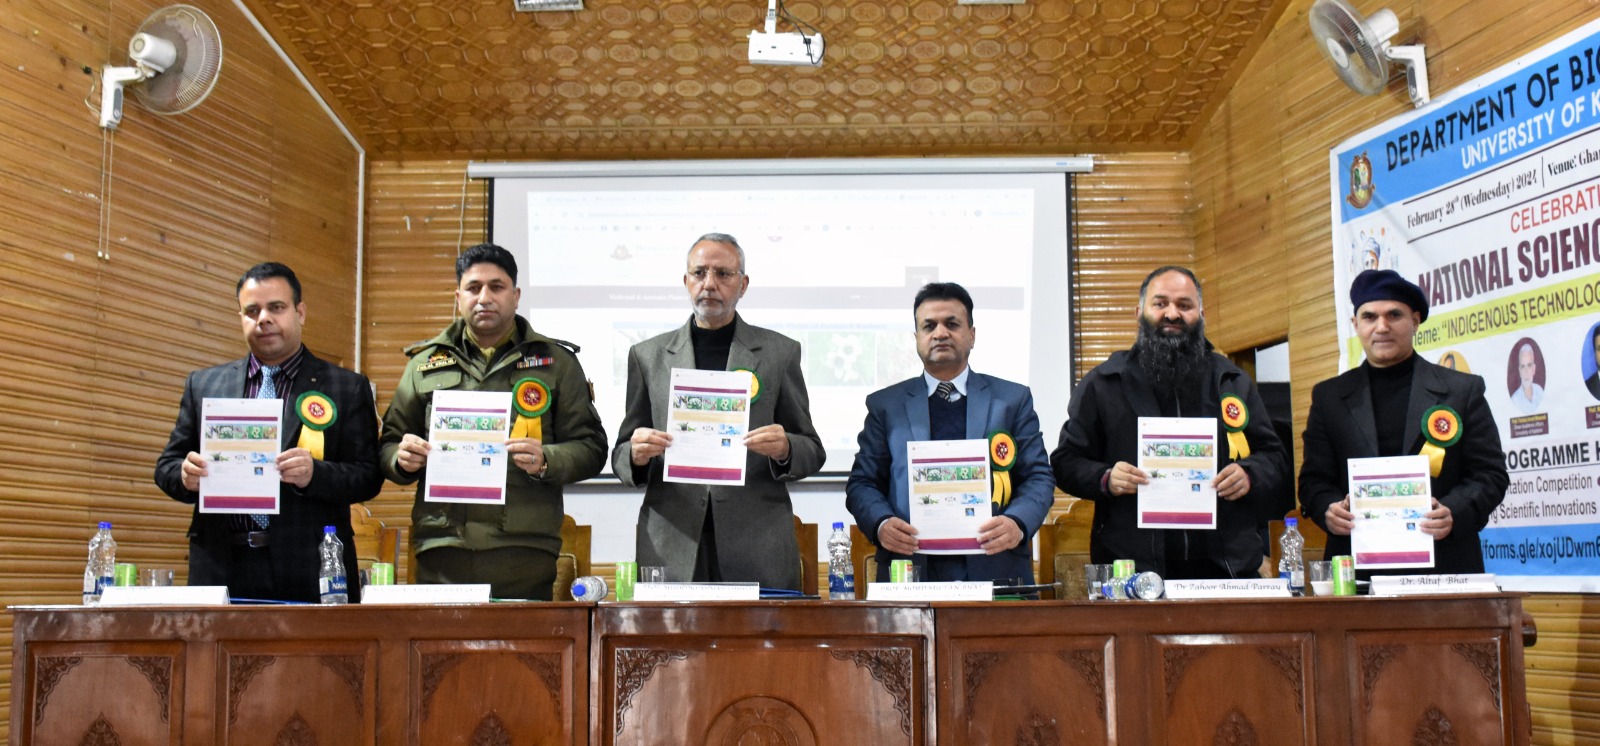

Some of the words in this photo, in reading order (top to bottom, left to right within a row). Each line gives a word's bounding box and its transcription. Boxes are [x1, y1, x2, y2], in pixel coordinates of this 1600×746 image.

[1386, 83, 1517, 172] DEPARTMENT
[1527, 63, 1560, 109] OF
[1569, 46, 1600, 92] BI
[1461, 108, 1555, 169] UNIVERSITY
[1561, 95, 1586, 128] OF
[1407, 206, 1444, 229] February
[1460, 177, 1515, 211] (Wednesday)
[1516, 168, 1537, 190] 2024
[1547, 154, 1577, 177] Venue:
[1419, 246, 1514, 308] NATIONAL
[1500, 501, 1541, 520] Scientific
[1542, 497, 1597, 517] Innovations
[1536, 473, 1593, 495] Competition
